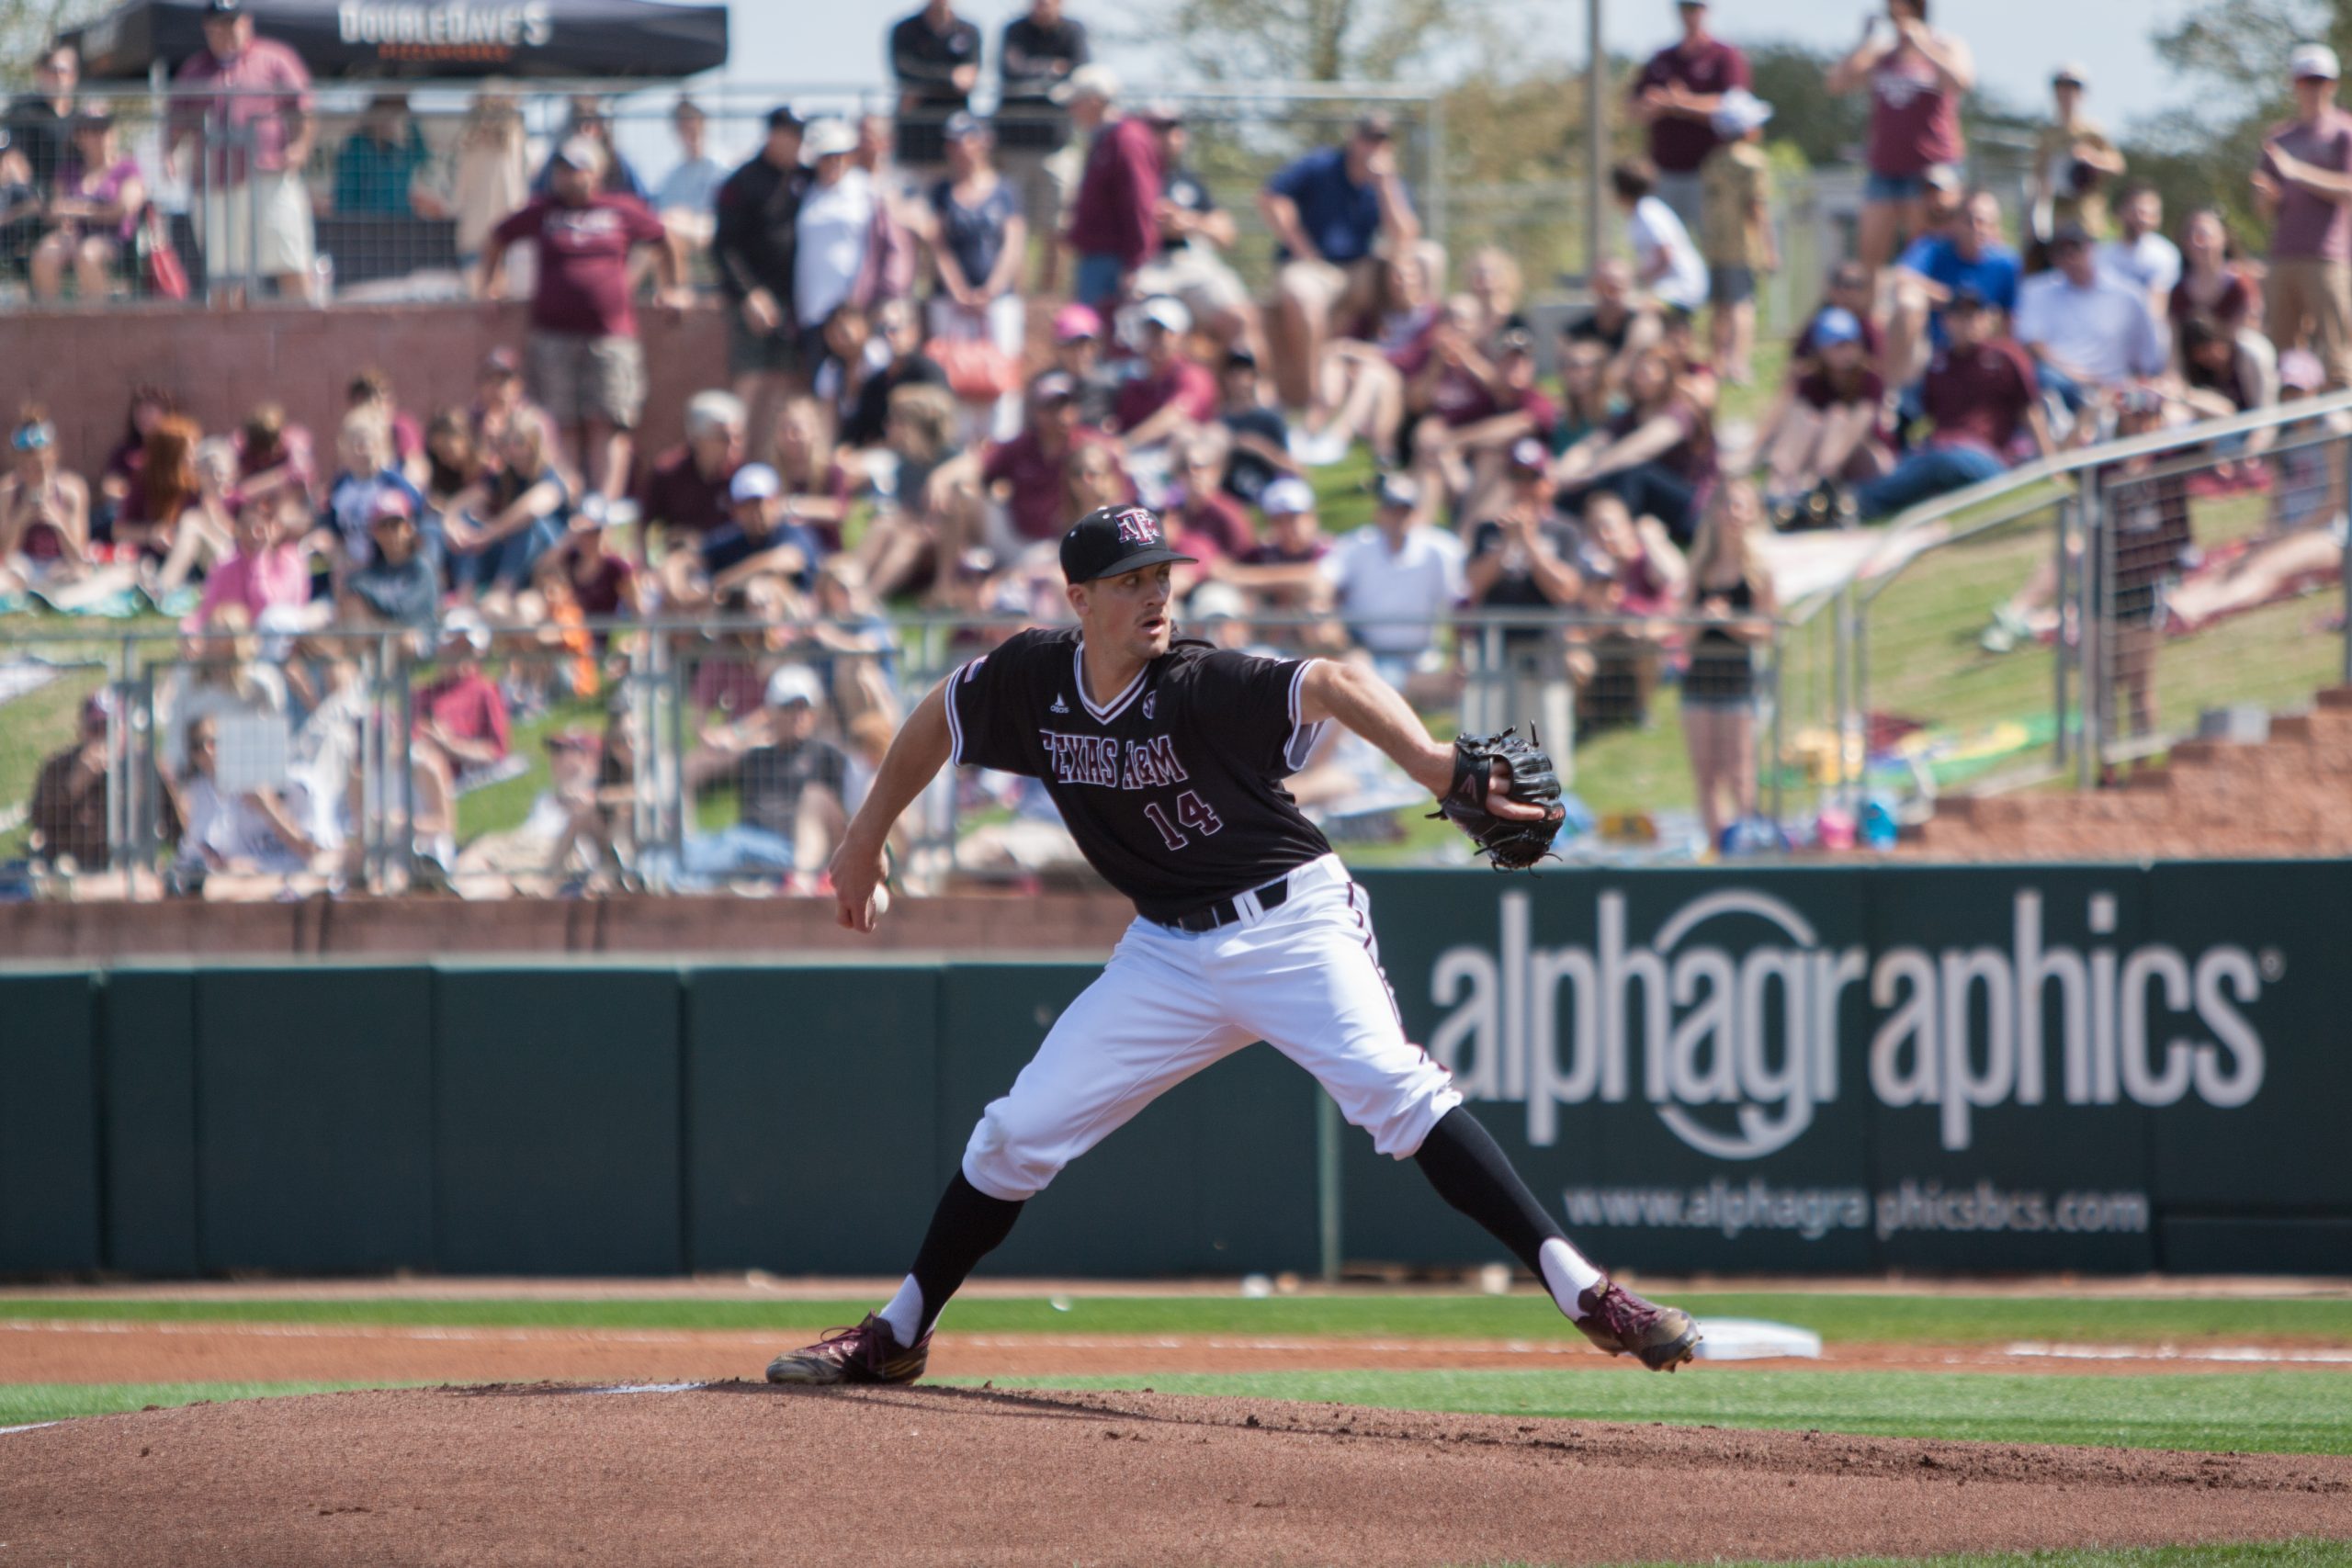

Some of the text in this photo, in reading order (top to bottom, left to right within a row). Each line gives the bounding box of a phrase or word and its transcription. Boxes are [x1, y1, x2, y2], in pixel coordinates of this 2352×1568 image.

[1039, 728, 1189, 790] TEXAS A&M
[1144, 789, 1225, 852] 14
